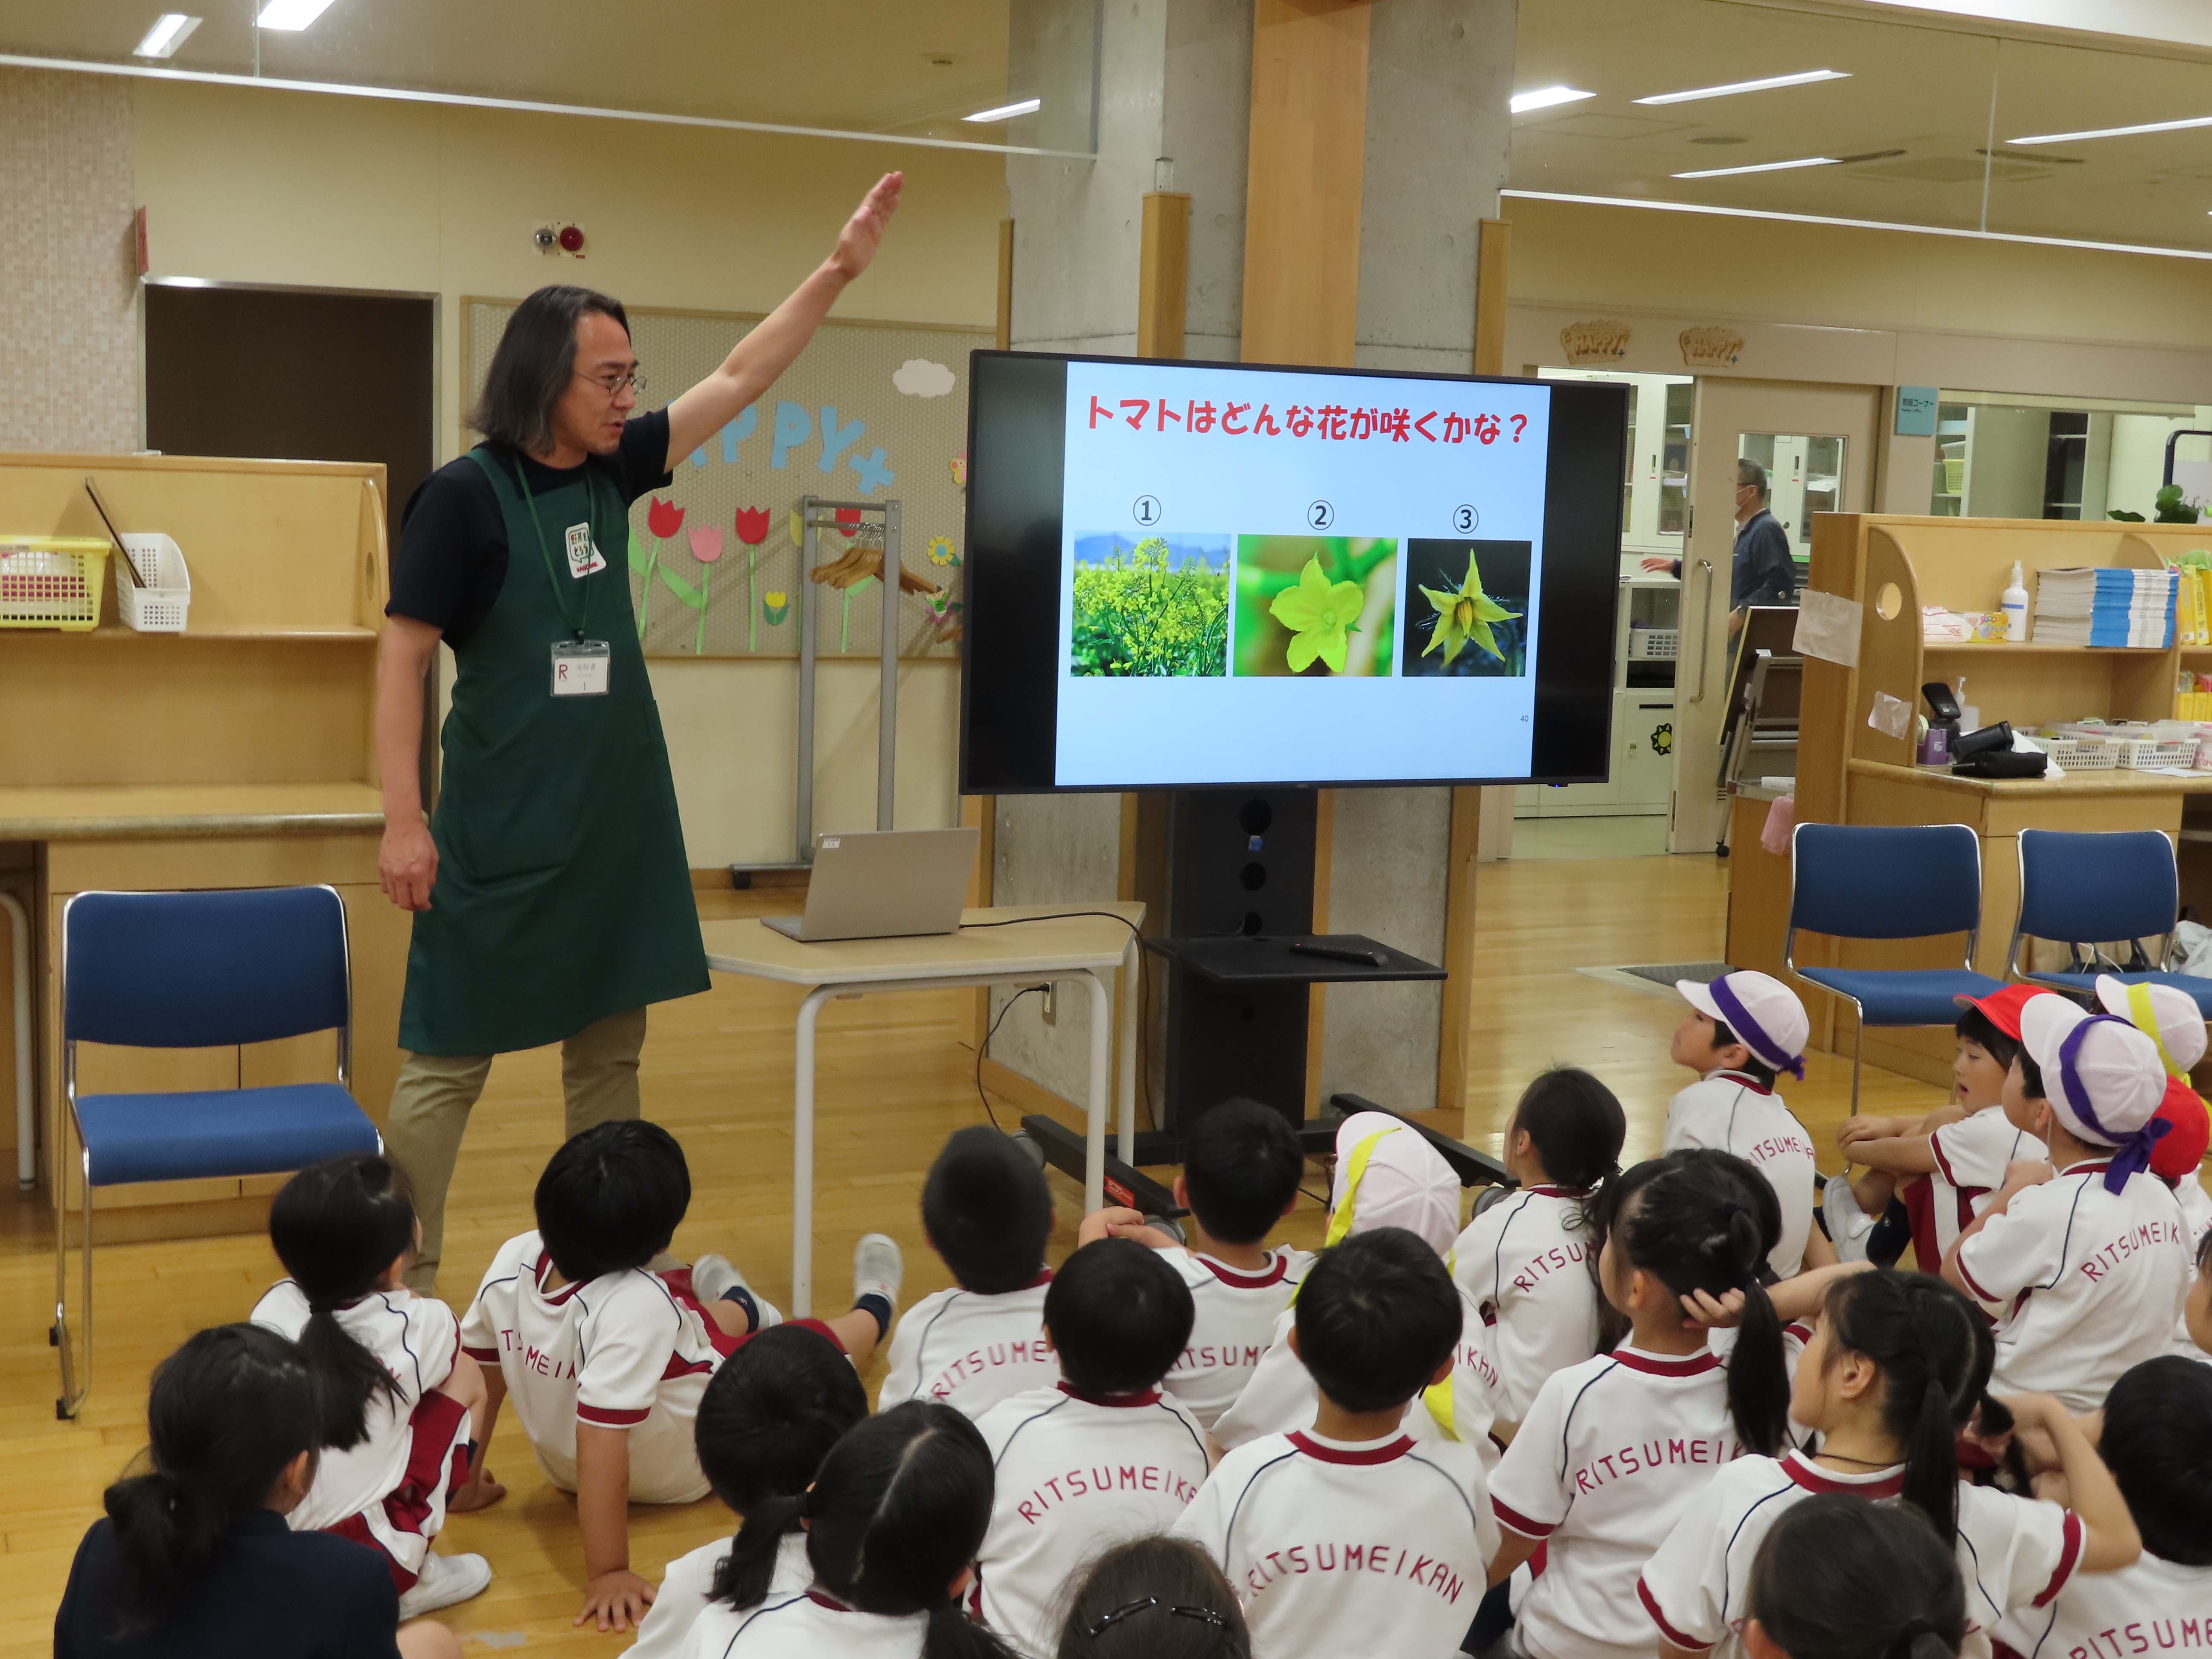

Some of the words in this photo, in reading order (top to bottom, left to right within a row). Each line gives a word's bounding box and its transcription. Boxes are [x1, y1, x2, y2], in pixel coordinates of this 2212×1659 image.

[1903, 398, 1934, 407] コーナー
[1089, 394, 1528, 445] トマトはどんな花が咲くかな？
[559, 664, 568, 679] R
[1170, 1346, 1272, 1372] TSUM
[1248, 1543, 1464, 1605] RITSUMEIKAN
